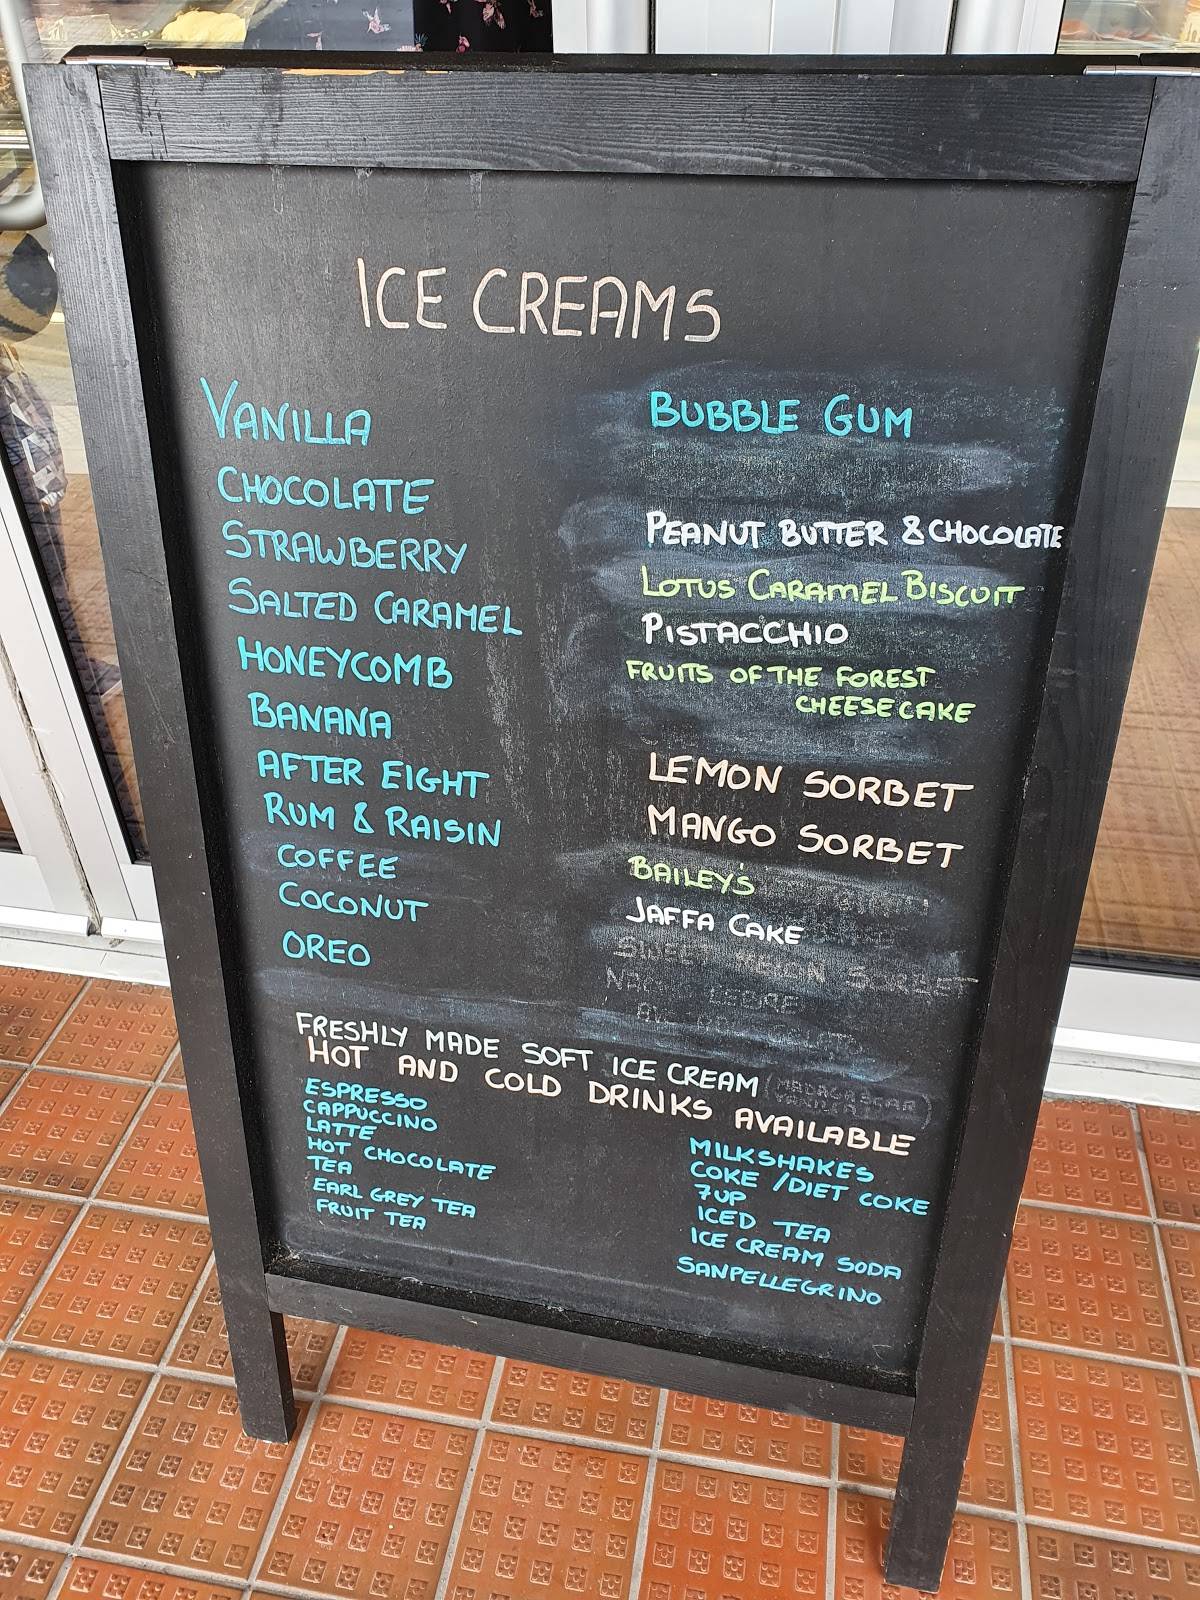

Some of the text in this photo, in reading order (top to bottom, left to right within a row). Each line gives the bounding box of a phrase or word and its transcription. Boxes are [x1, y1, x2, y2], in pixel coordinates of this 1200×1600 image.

[357, 257, 721, 342] ICE CREAMS
[200, 377, 372, 446] VANILLA
[650, 391, 913, 438] BUBBLE GUM
[217, 466, 435, 514] CHOCOLATE
[222, 519, 468, 574] STRAWBERRY
[646, 511, 766, 549] PEANUT
[780, 520, 888, 548] BUTTER
[228, 577, 523, 635] SALTED CARAMEL
[641, 565, 1024, 607] LOTUS CARAMEL BISCUIT
[641, 612, 849, 648] PISTACCHIO
[237, 636, 453, 689] HONEYCOMB
[626, 660, 936, 689] FRUITS OF THE FOREST
[248, 692, 392, 739] BANANA
[257, 749, 490, 798] AFTER EIGHT
[648, 752, 974, 812] LEMON SORBET
[264, 792, 501, 847] RUM & RAISIN
[647, 804, 964, 869] MANGO SORBET
[277, 844, 399, 879] COFFEE
[628, 855, 756, 896] BAILEY'S
[278, 882, 429, 922] COCONUT
[626, 896, 804, 945] JAFFA CAKE
[282, 930, 371, 967] OREO
[296, 1011, 759, 1098] FRESHLY MADE SOFT ICE CREAM
[303, 1099, 438, 1132] CAPPUCCINO
[305, 1077, 428, 1111] ESPRESSO
[307, 1036, 916, 1156] HOT AND COLD DRINKS AVAILABLE
[306, 1116, 377, 1140] LATTE
[307, 1136, 496, 1181] HOT CHOCOLATE
[307, 1155, 353, 1175] TEA
[689, 1137, 875, 1183] MILKSHAKES
[313, 1177, 476, 1218] EARL GREY TEA
[690, 1161, 760, 1188] COKE
[858, 1192, 931, 1216] COKE
[316, 1199, 426, 1231] FRUIT TEA
[697, 1206, 832, 1244] ICED TEA
[691, 1227, 902, 1280] ICE CREAM SODA
[677, 1256, 882, 1306] SANPELLEGRINO
